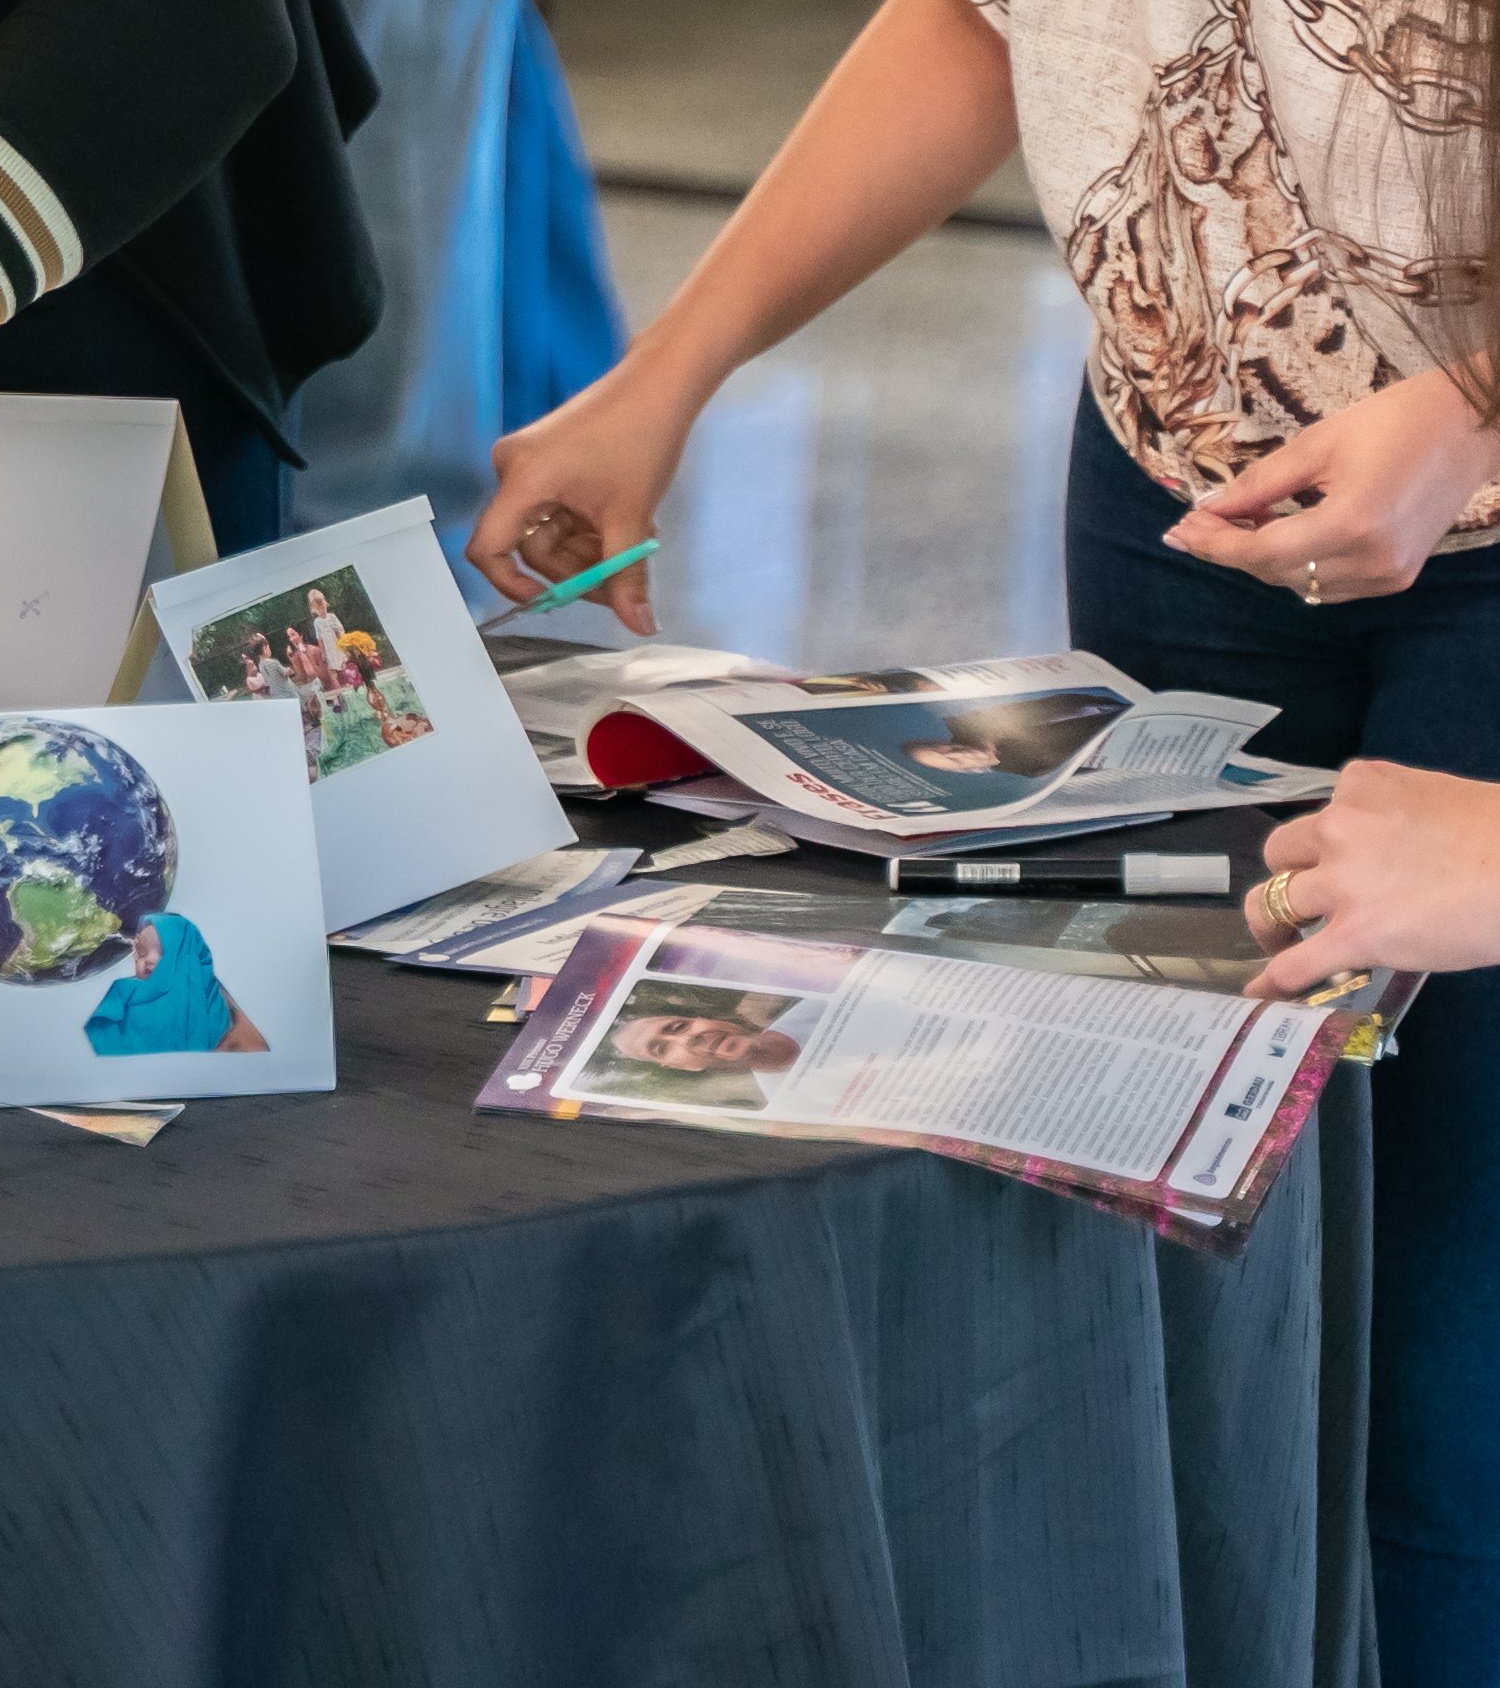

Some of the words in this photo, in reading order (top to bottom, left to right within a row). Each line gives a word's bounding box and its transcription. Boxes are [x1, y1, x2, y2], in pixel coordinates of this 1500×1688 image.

[785, 772, 898, 820] Frases
[532, 1043, 564, 1073] HUGO
[552, 991, 597, 1043] WERNECK
